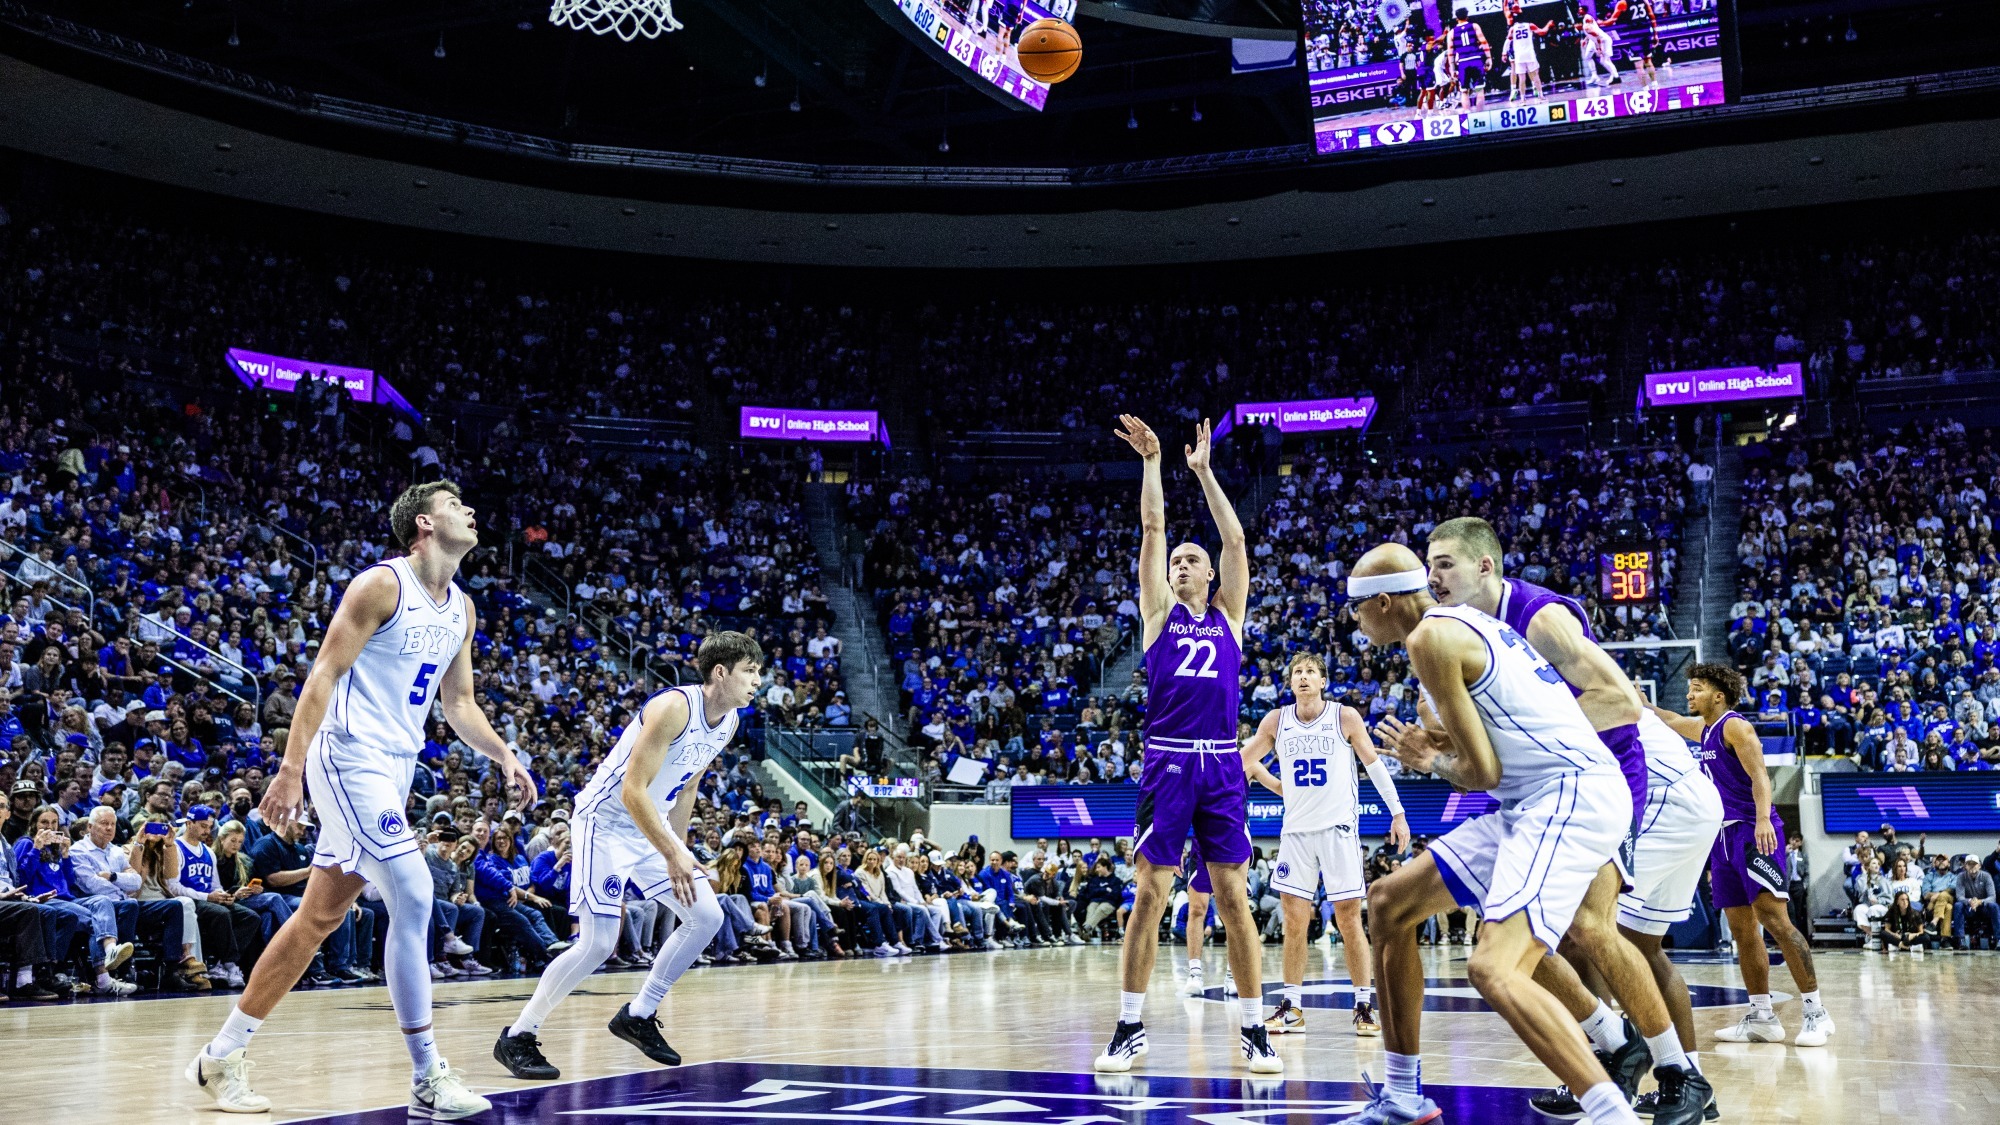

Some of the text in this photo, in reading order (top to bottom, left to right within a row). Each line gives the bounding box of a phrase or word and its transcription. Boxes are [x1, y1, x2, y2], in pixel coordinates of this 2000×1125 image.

[914, 2, 935, 33] 8:02
[1629, 3, 1647, 20] 23
[1515, 29, 1528, 40] 25
[1664, 33, 1719, 53] ASKE
[954, 39, 971, 61] 43
[1311, 83, 1397, 108] BASKET
[1501, 107, 1538, 128] 8:02
[1551, 106, 1564, 119] 30
[1584, 99, 1609, 117] 43
[1430, 118, 1454, 137] 82
[1654, 374, 1793, 395] BYU Online High School
[749, 416, 869, 433] BYU Online High School
[1283, 411, 1308, 422] Online
[1309, 409, 1333, 422] High
[1334, 407, 1367, 419] School
[1613, 551, 1648, 570] 8:02
[1611, 571, 1646, 600] 30
[1168, 621, 1224, 637] HOLY CROSS
[1173, 637, 1219, 678] 22
[408, 663, 438, 706] 5
[1284, 735, 1335, 758] BYU
[1293, 758, 1328, 787] 25
[902, 787, 913, 796] 43
[188, 862, 212, 877] BYU
[1753, 857, 1784, 886] CRUSADERS
